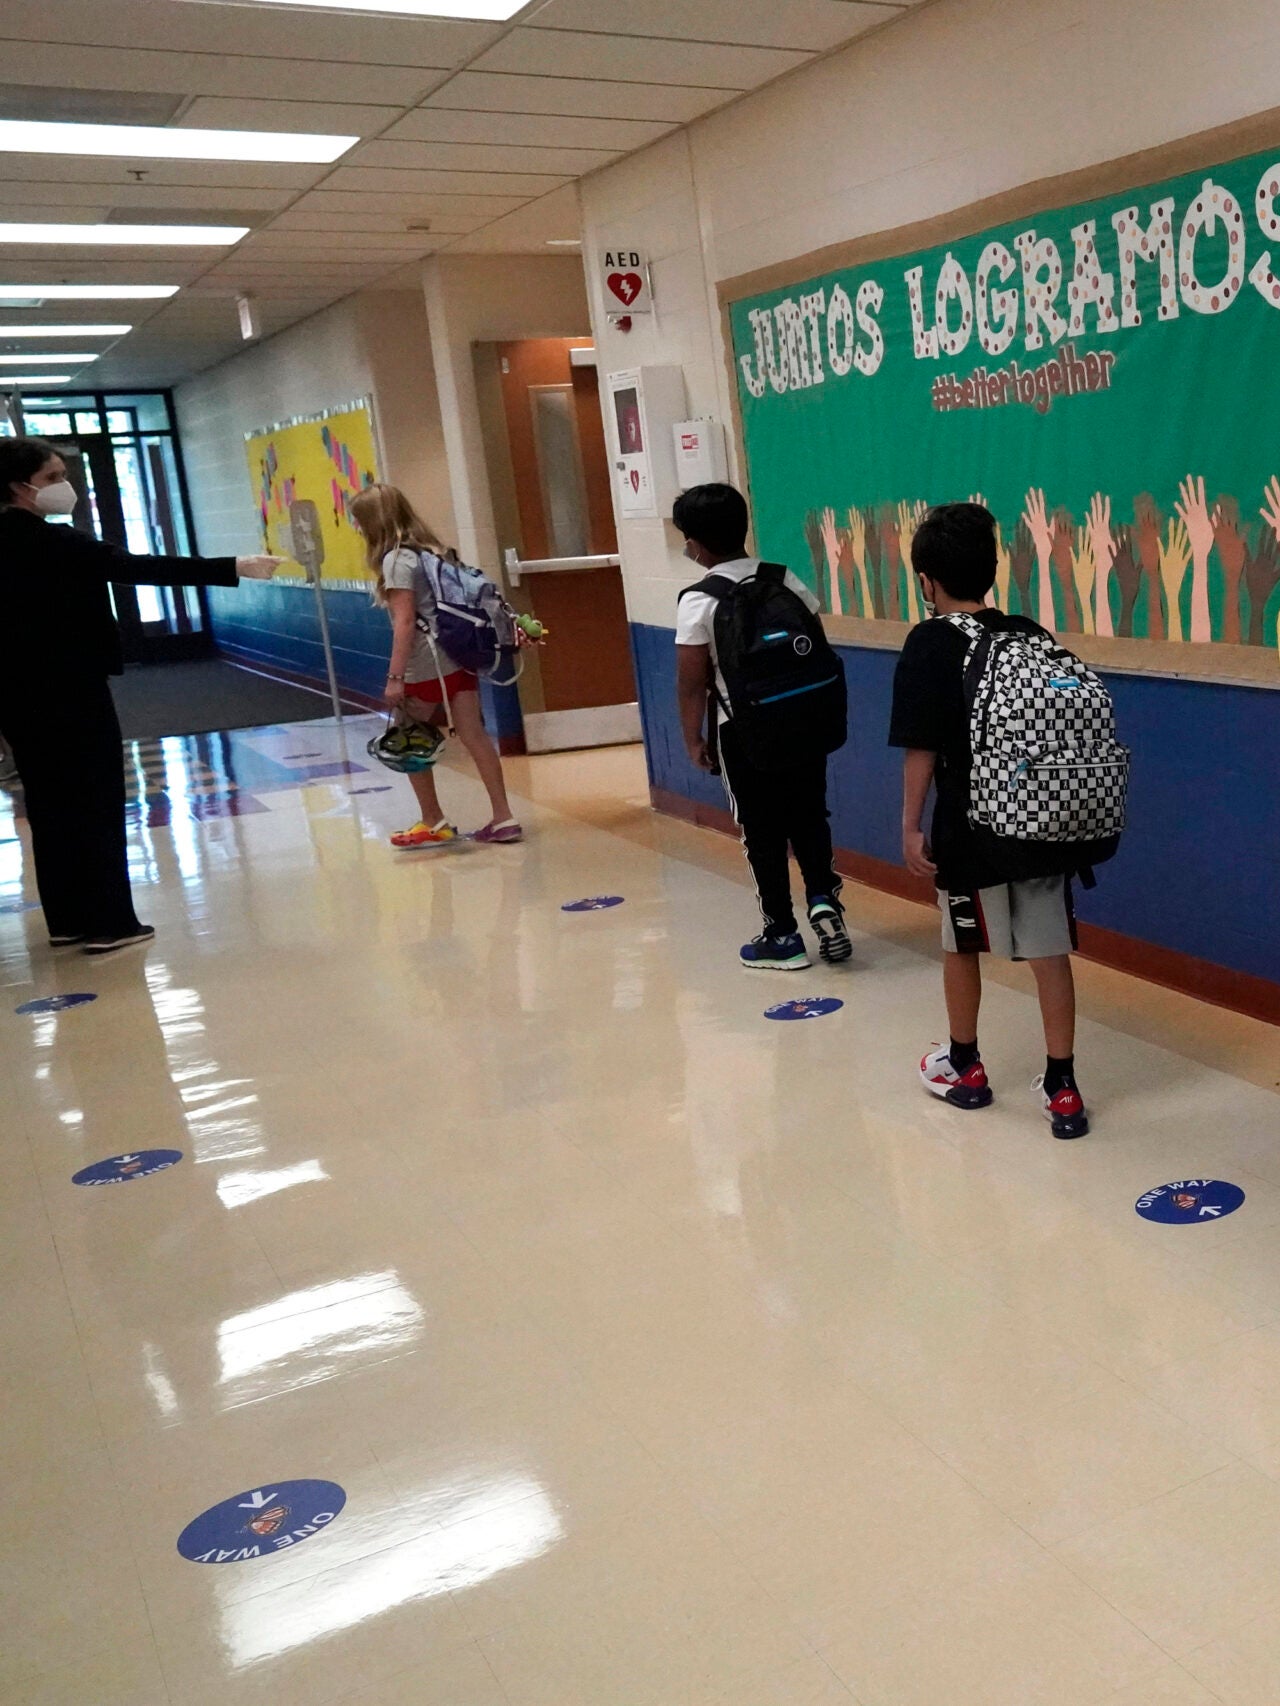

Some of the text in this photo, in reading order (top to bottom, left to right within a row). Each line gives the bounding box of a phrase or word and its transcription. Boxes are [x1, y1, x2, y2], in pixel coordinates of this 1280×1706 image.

[605, 252, 640, 267] AED
[739, 280, 884, 398] JUNTOS
[1136, 1179, 1213, 1209] ONE WAY
[193, 1511, 335, 1562] ONE WAY
